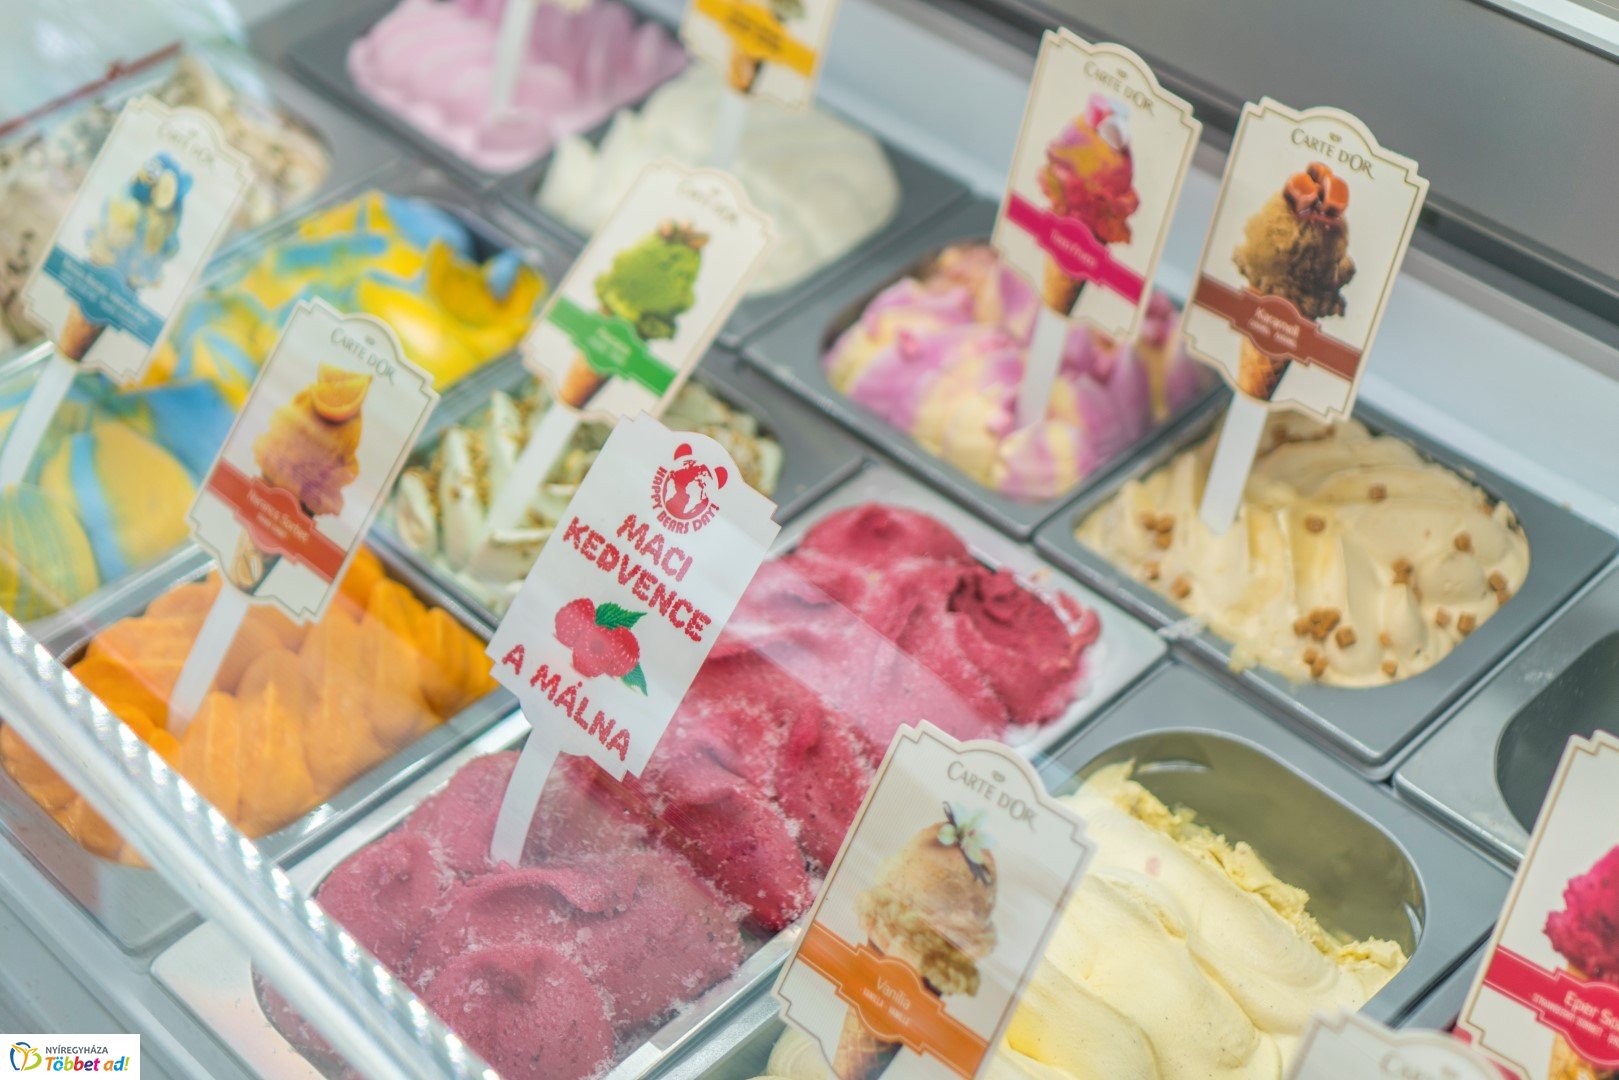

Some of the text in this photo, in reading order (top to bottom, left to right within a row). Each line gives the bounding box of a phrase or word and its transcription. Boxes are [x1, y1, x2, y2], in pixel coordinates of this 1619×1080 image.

[1291, 128, 1335, 158] CARTE
[651, 466, 719, 534] HAPPY BEARS DAY!
[563, 516, 712, 642] KEDVENCE
[617, 514, 694, 583] MACI
[502, 644, 631, 762] A MÁLNA
[947, 760, 997, 800] CARTE
